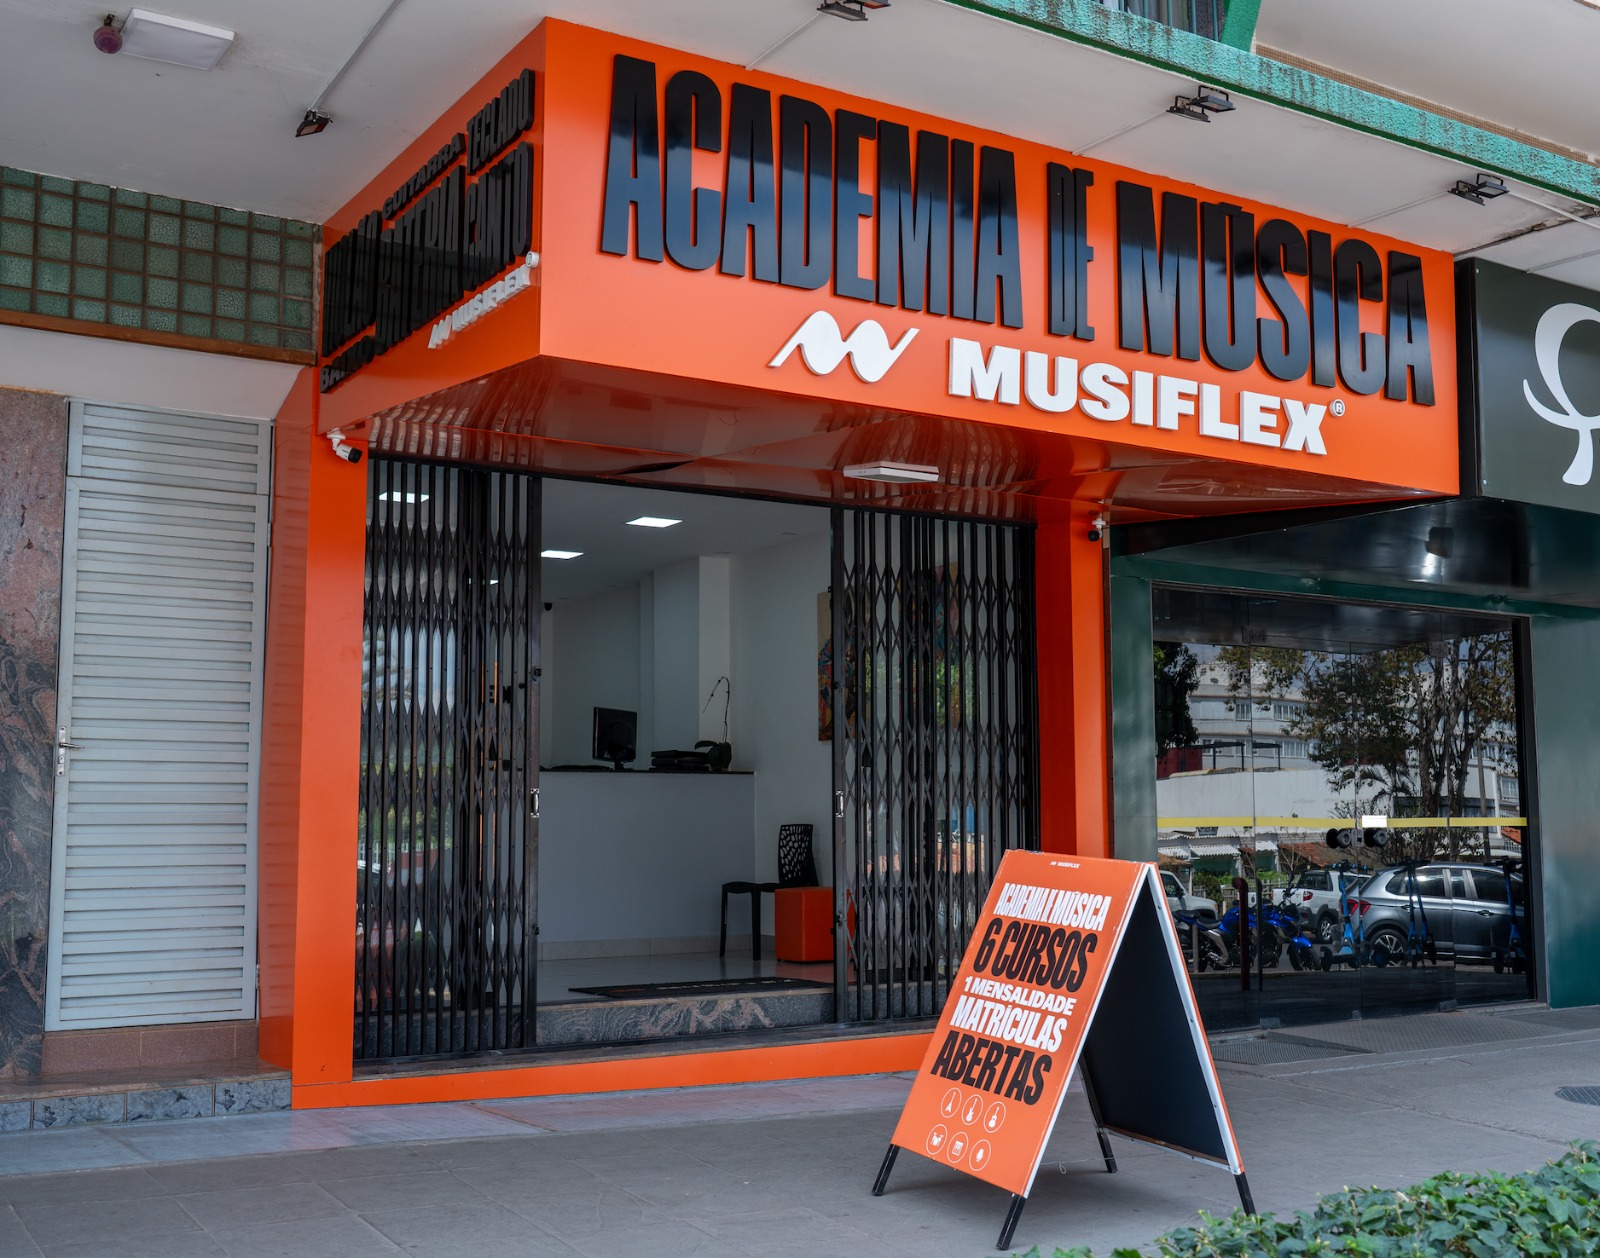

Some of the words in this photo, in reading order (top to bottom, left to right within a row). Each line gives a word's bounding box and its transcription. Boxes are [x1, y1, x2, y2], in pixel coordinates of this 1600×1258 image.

[467, 68, 535, 176] TECLADO
[381, 133, 466, 221] GUITARRA
[462, 141, 534, 291] CANTO
[374, 165, 466, 355] BATERIA
[600, 53, 1023, 328] ACADEMIA
[1046, 161, 1095, 341] DE
[1115, 180, 1436, 406] MÚSICA
[322, 210, 382, 358] VIOLÃO
[319, 336, 375, 394] BAIXO
[993, 882, 1051, 922] ACADEMIA
[1048, 889, 1112, 932] MÚSICA
[963, 975, 974, 993] 1
[970, 977, 1078, 1017] MENSALIDADE
[973, 917, 1003, 973] 6
[991, 920, 1098, 993] CURSOS
[950, 994, 1068, 1053] MATRÍCULAS
[930, 1029, 1053, 1106] ABERTAS
